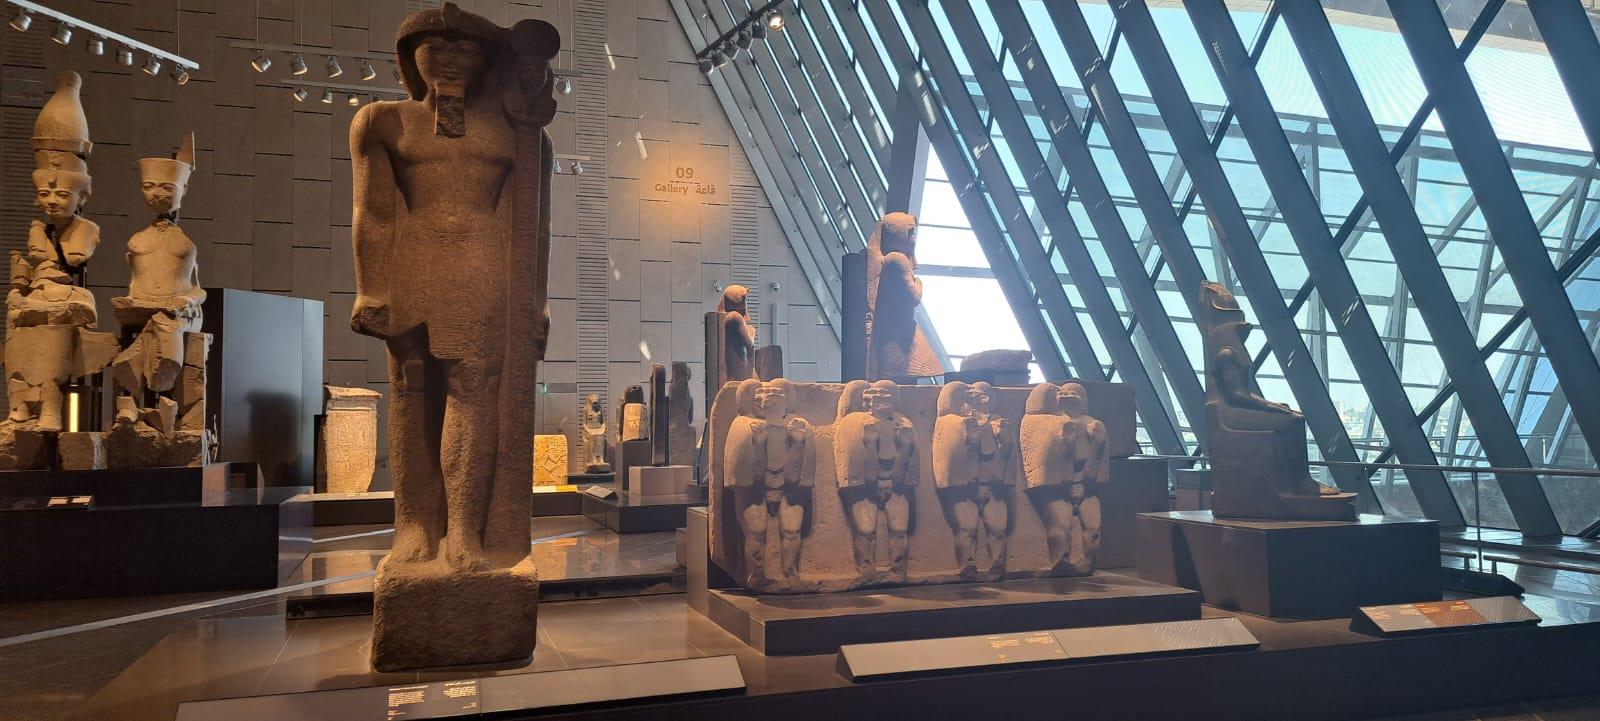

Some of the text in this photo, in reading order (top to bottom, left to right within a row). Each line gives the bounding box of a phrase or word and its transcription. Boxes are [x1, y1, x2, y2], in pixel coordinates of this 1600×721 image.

[675, 167, 694, 179] 09
[654, 183, 689, 196] Gallery
[695, 184, 716, 195] قاعة
